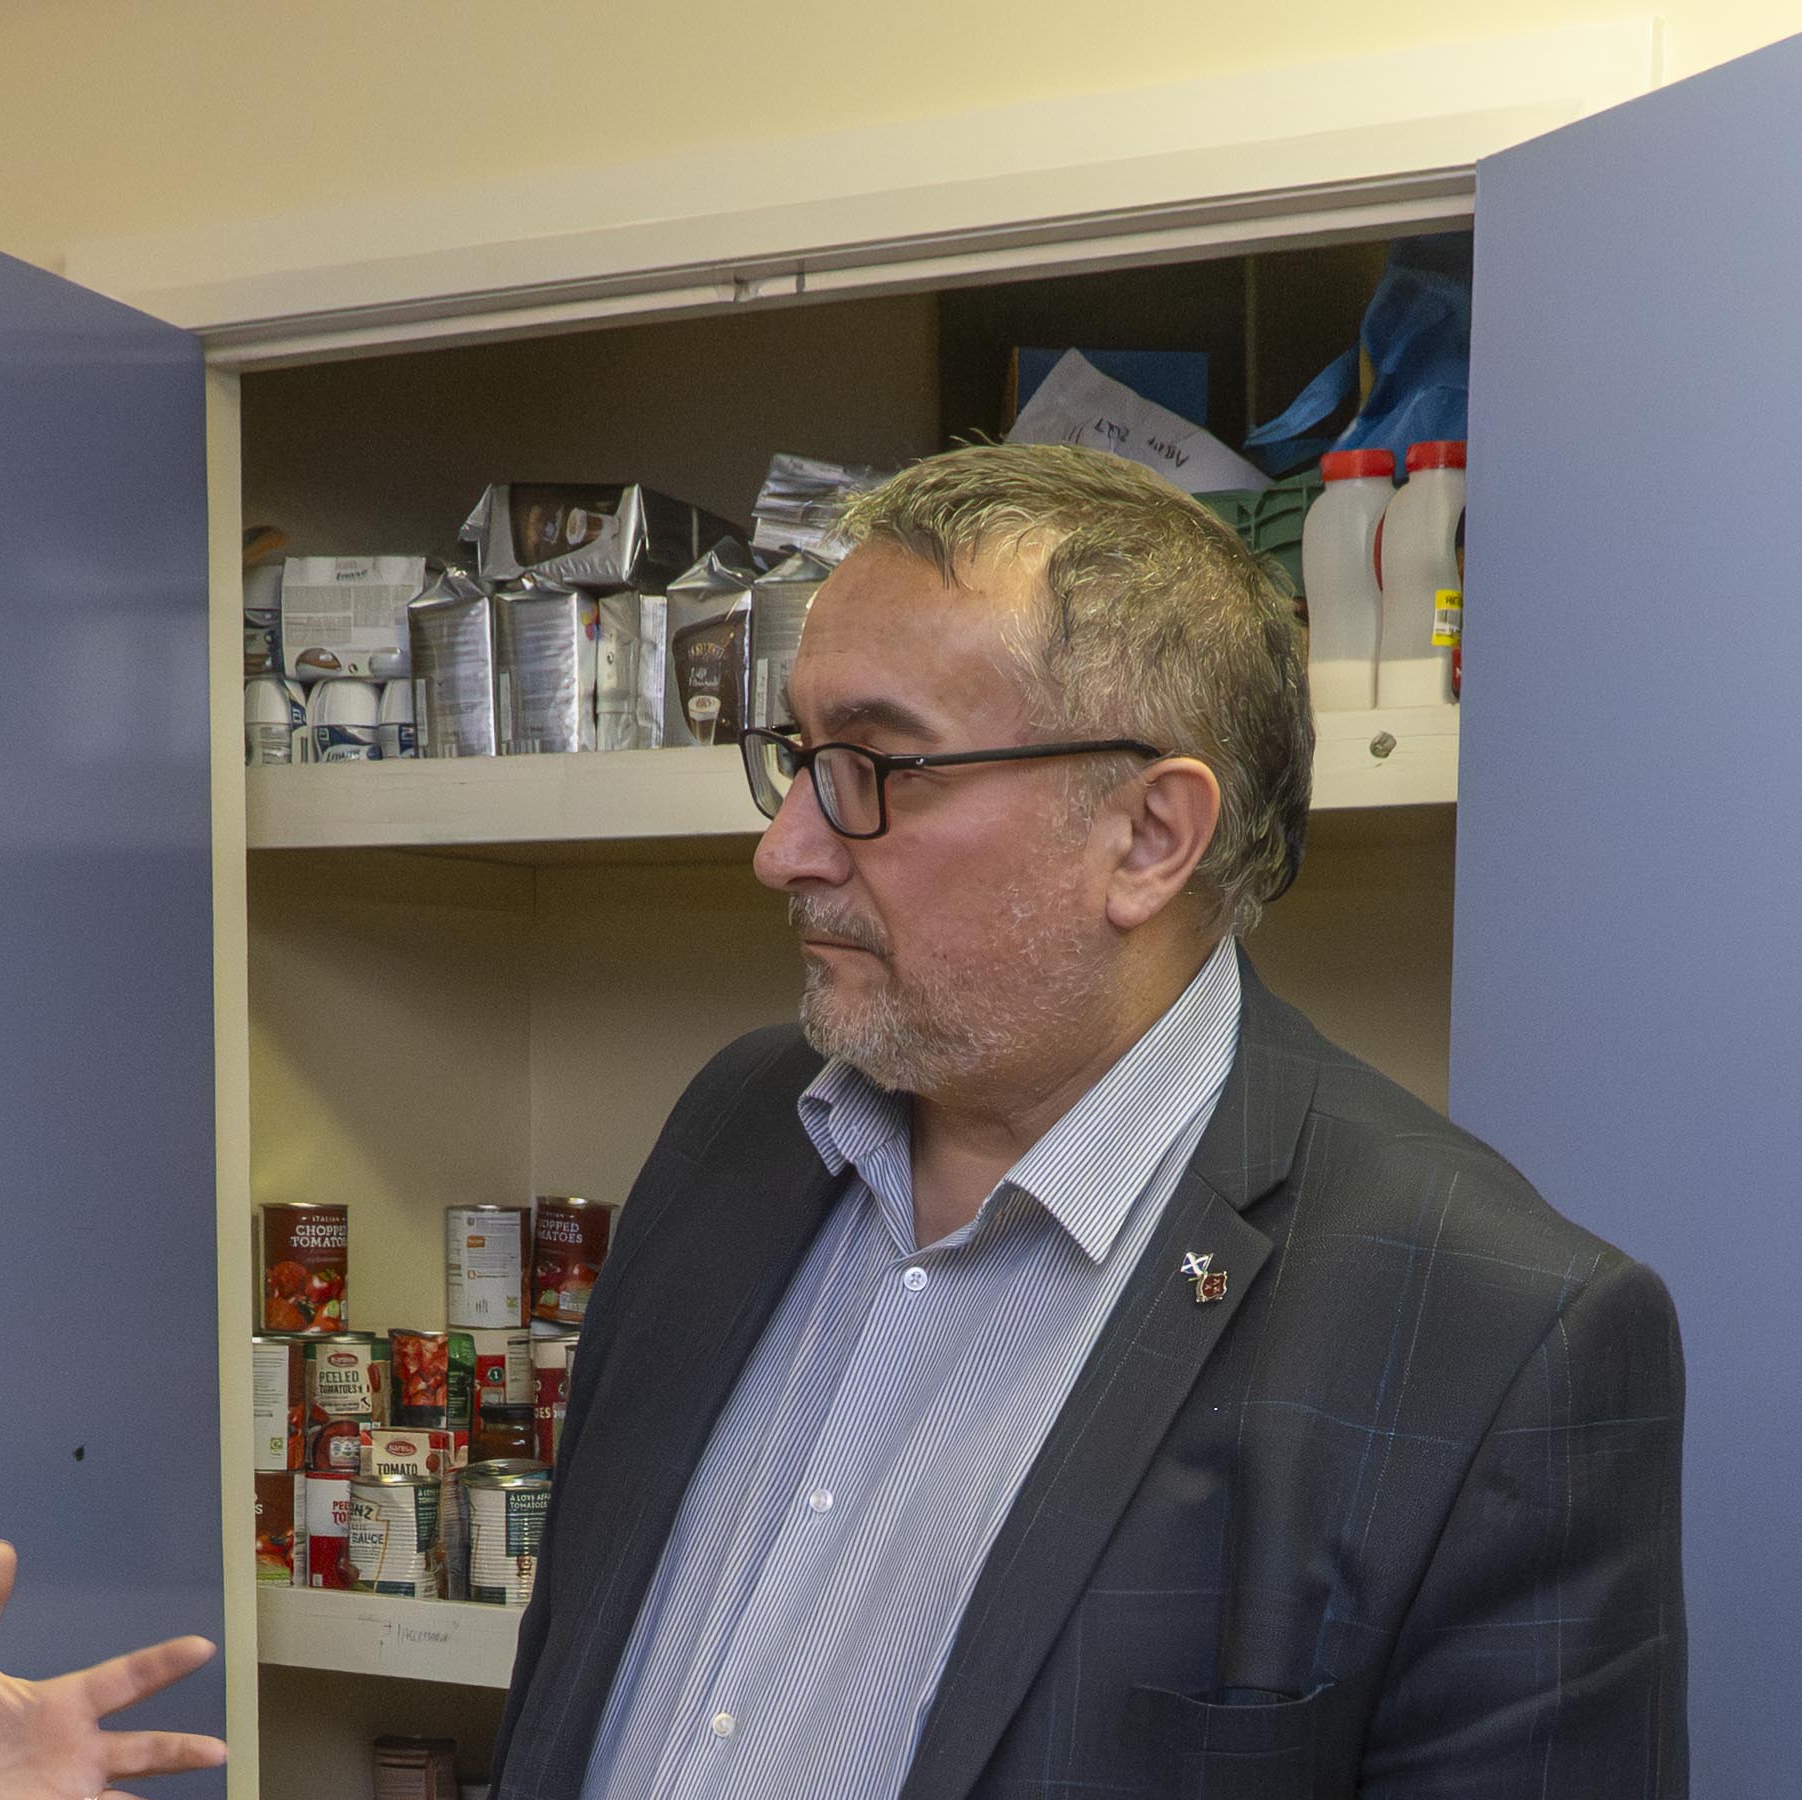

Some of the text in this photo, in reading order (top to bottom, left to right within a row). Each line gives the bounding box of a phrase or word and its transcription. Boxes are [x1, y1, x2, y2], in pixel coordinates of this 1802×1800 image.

[318, 1370, 360, 1384] PEELED
[376, 1463, 418, 1476] TOMATO
[351, 1532, 385, 1545] SAUCE
